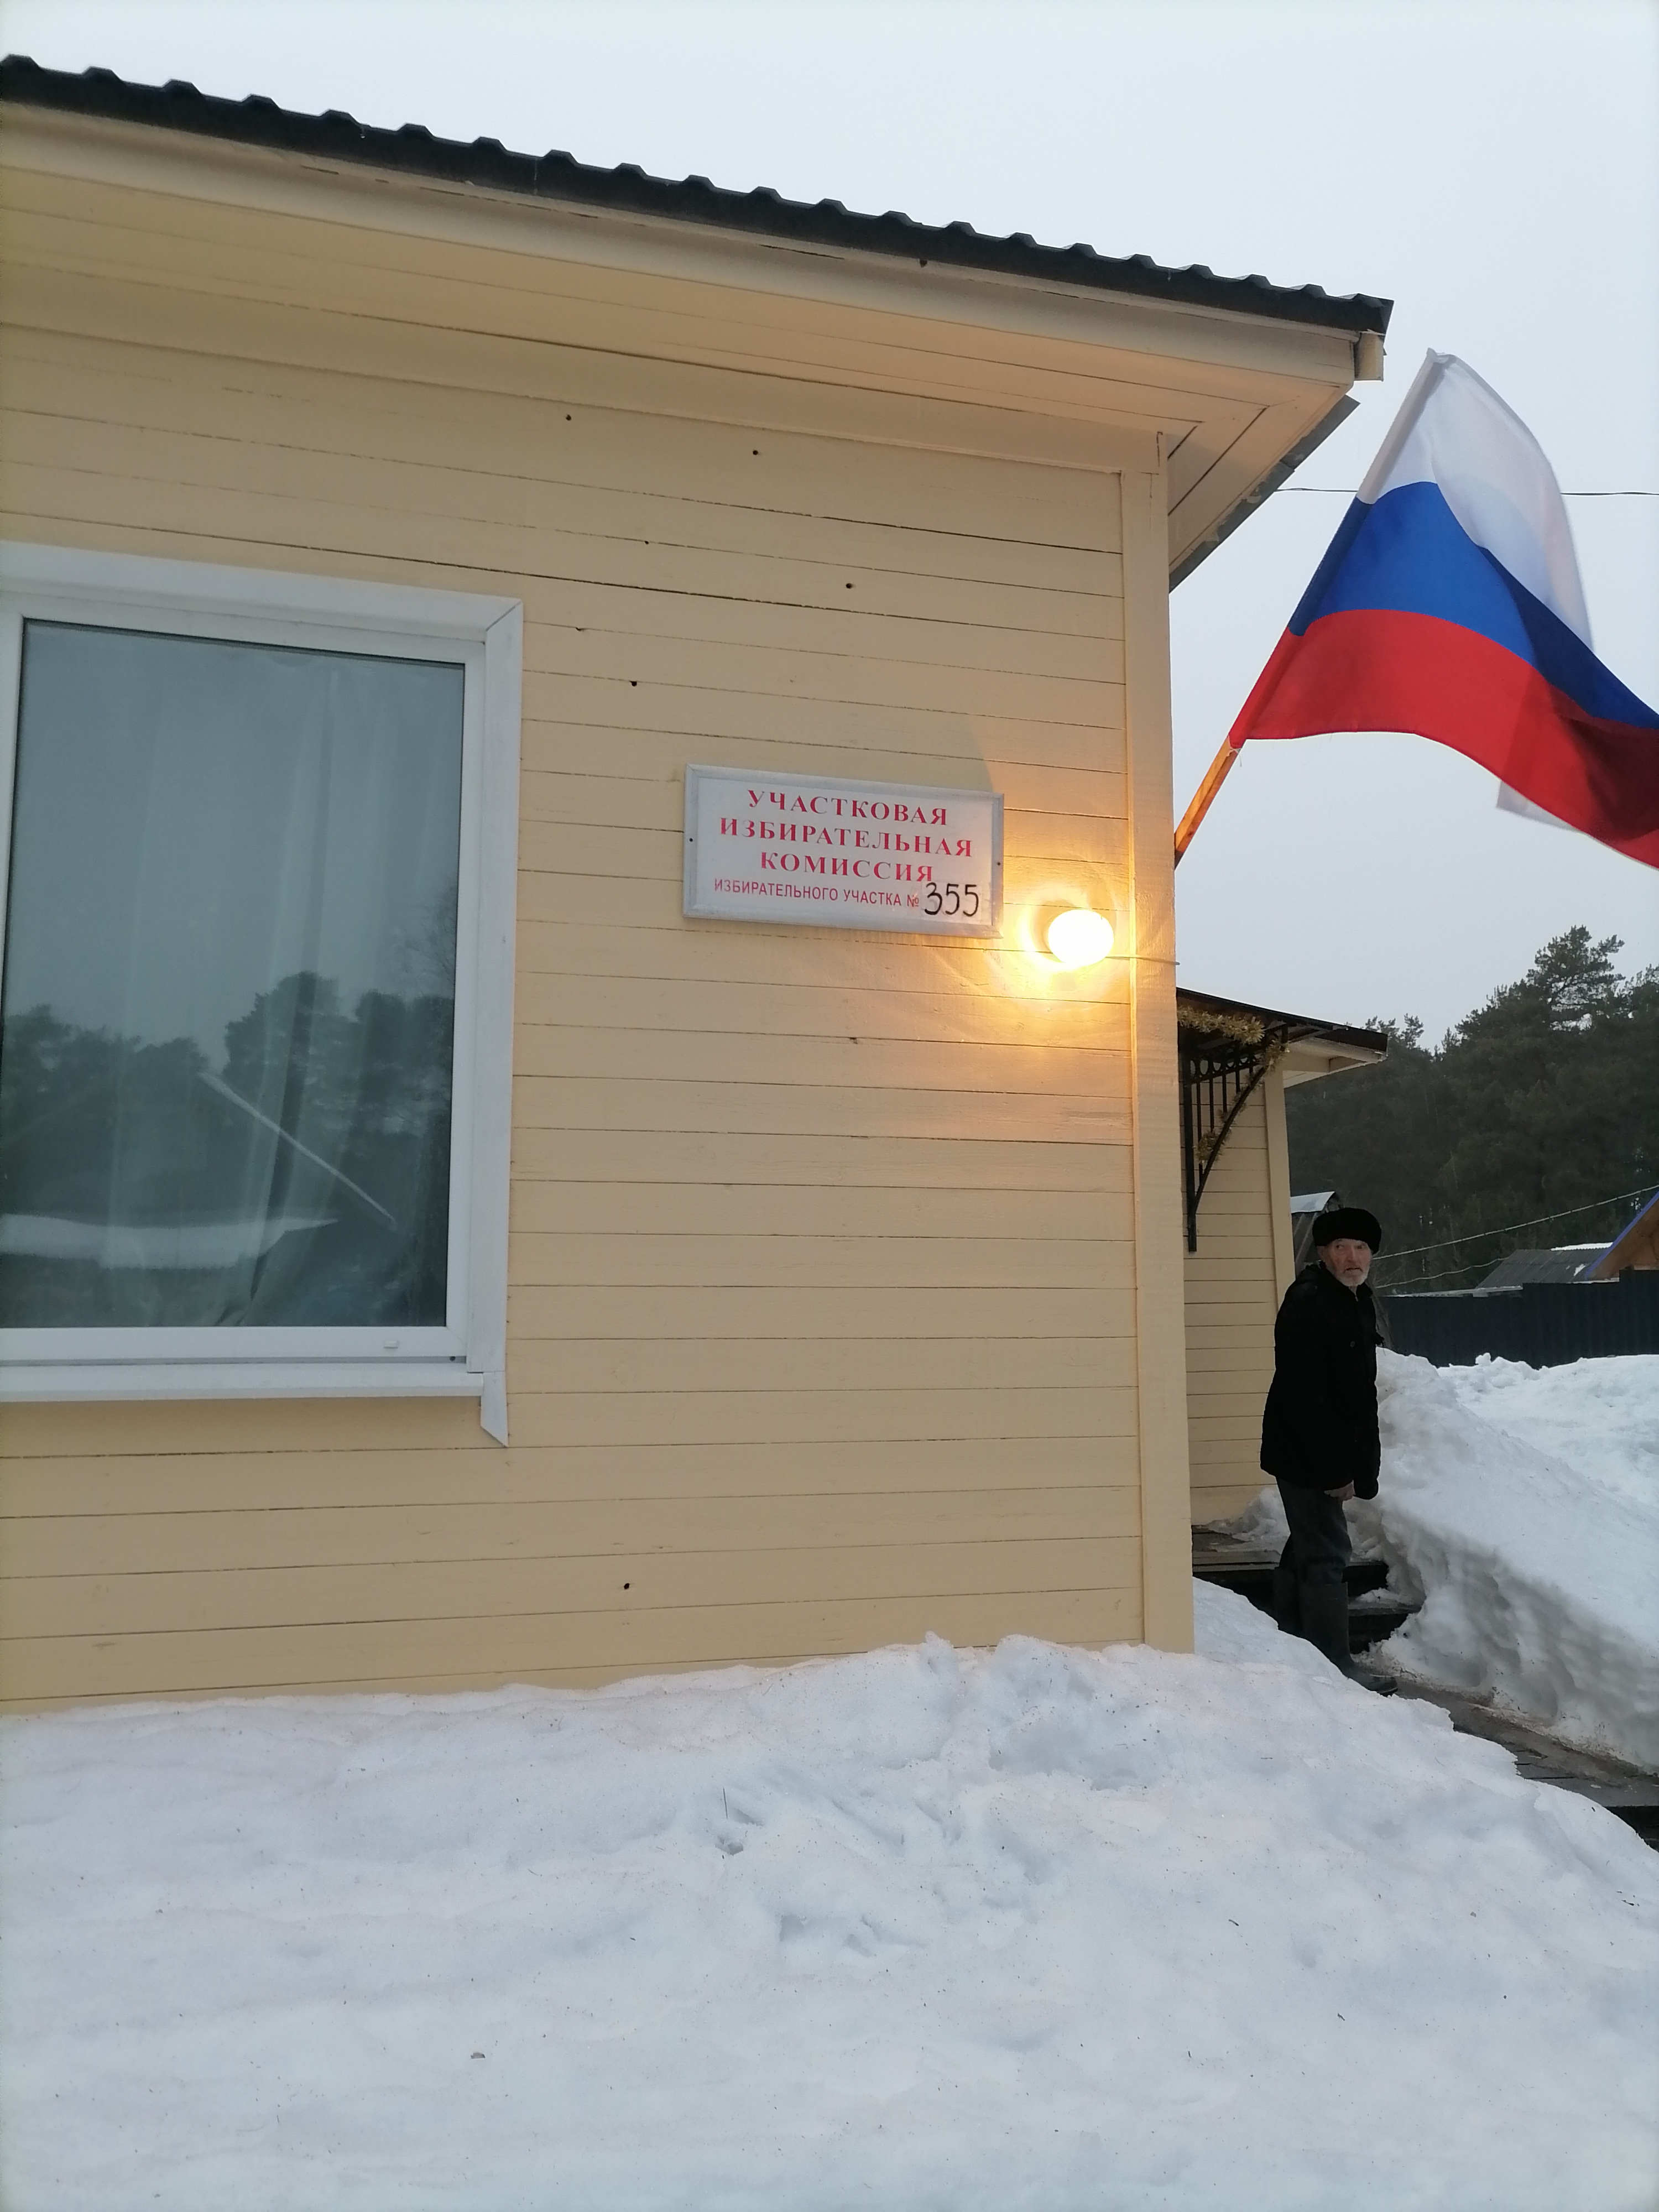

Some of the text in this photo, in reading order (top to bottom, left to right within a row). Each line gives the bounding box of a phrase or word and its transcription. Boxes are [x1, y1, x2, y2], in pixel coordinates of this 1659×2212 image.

[748, 790, 948, 826] УЧАСТКОВАЯ
[720, 817, 972, 857] ИЗБИРАТЕЛЬНАЯ
[760, 852, 933, 882] КОМИССИЯ
[714, 878, 838, 901] ИЗБИРАТЕЛЬНОГО
[844, 889, 901, 906] УЧАСТКА
[924, 882, 979, 917] 355
